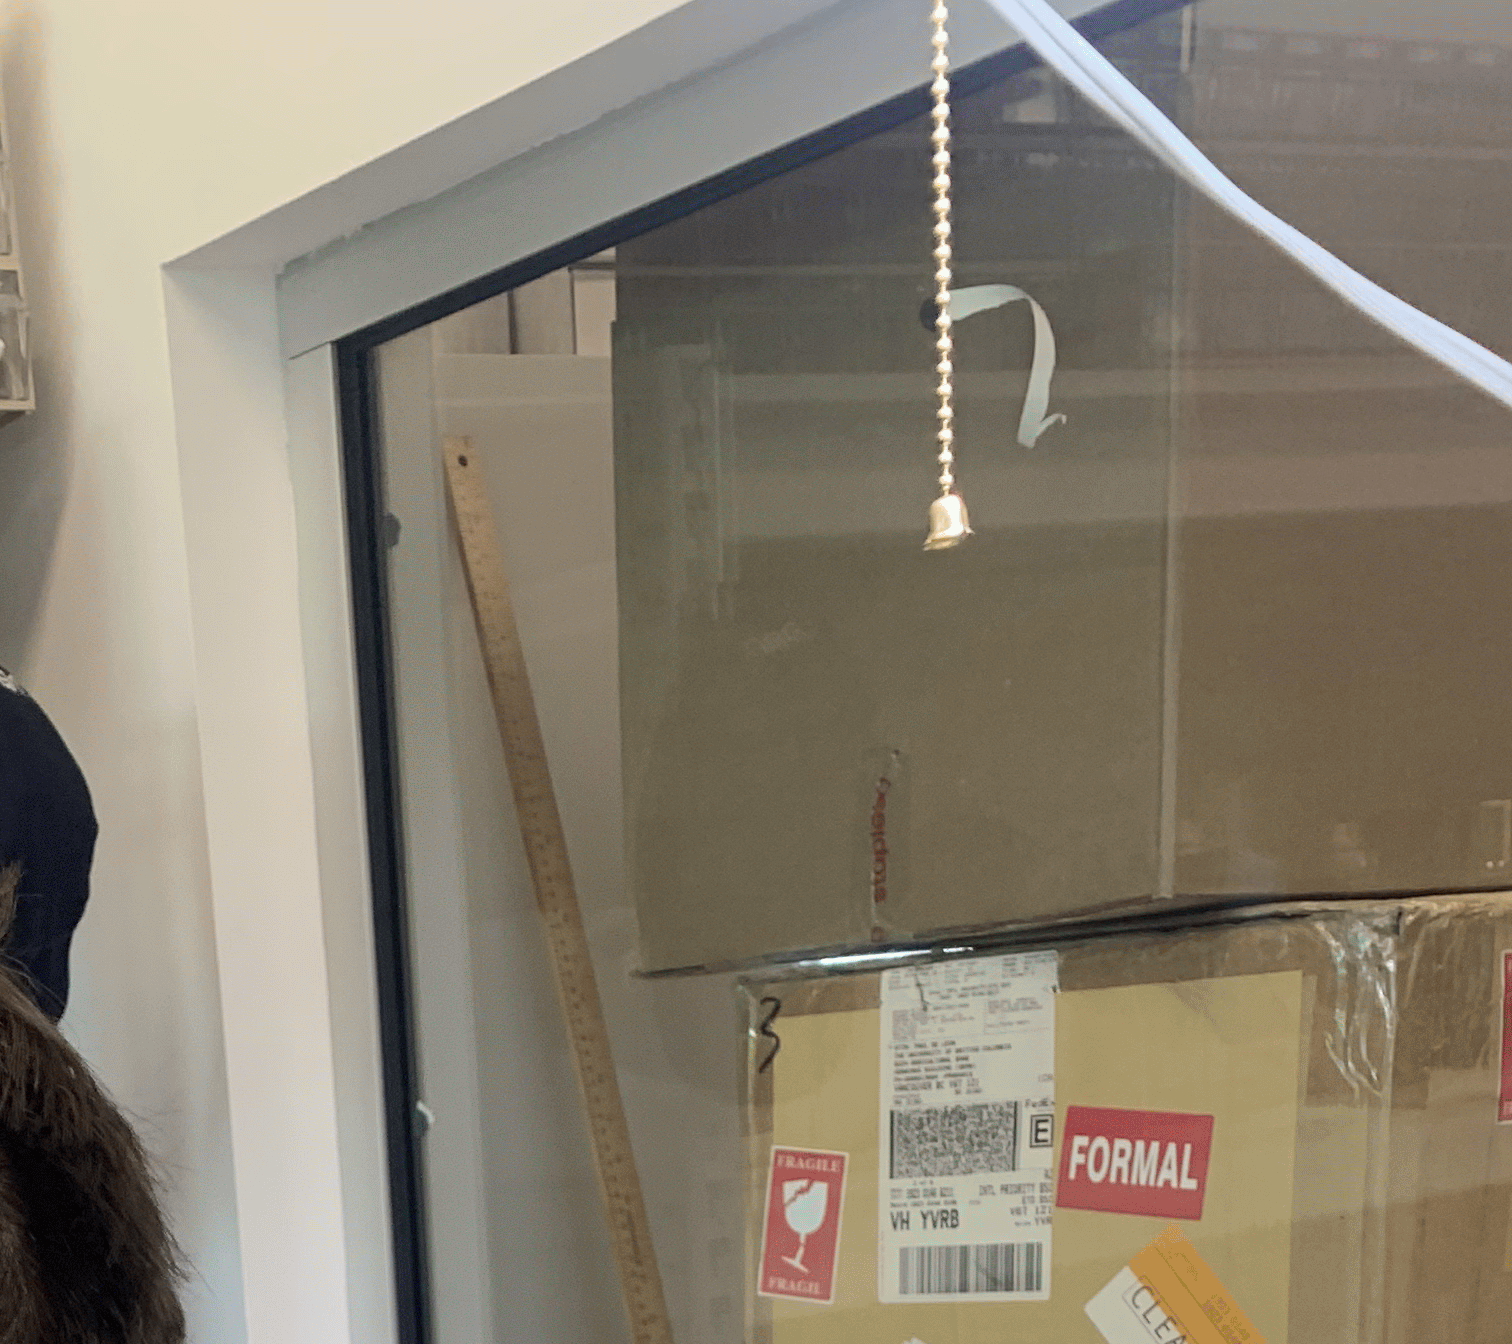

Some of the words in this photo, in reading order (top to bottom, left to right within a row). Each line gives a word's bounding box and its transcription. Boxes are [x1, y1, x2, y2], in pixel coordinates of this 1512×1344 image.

[1034, 1119, 1049, 1143] E
[776, 1154, 841, 1173] FRAGILE
[1069, 1135, 1198, 1191] FORMAL
[890, 1210, 910, 1231] VH
[920, 1208, 959, 1231] YVRB
